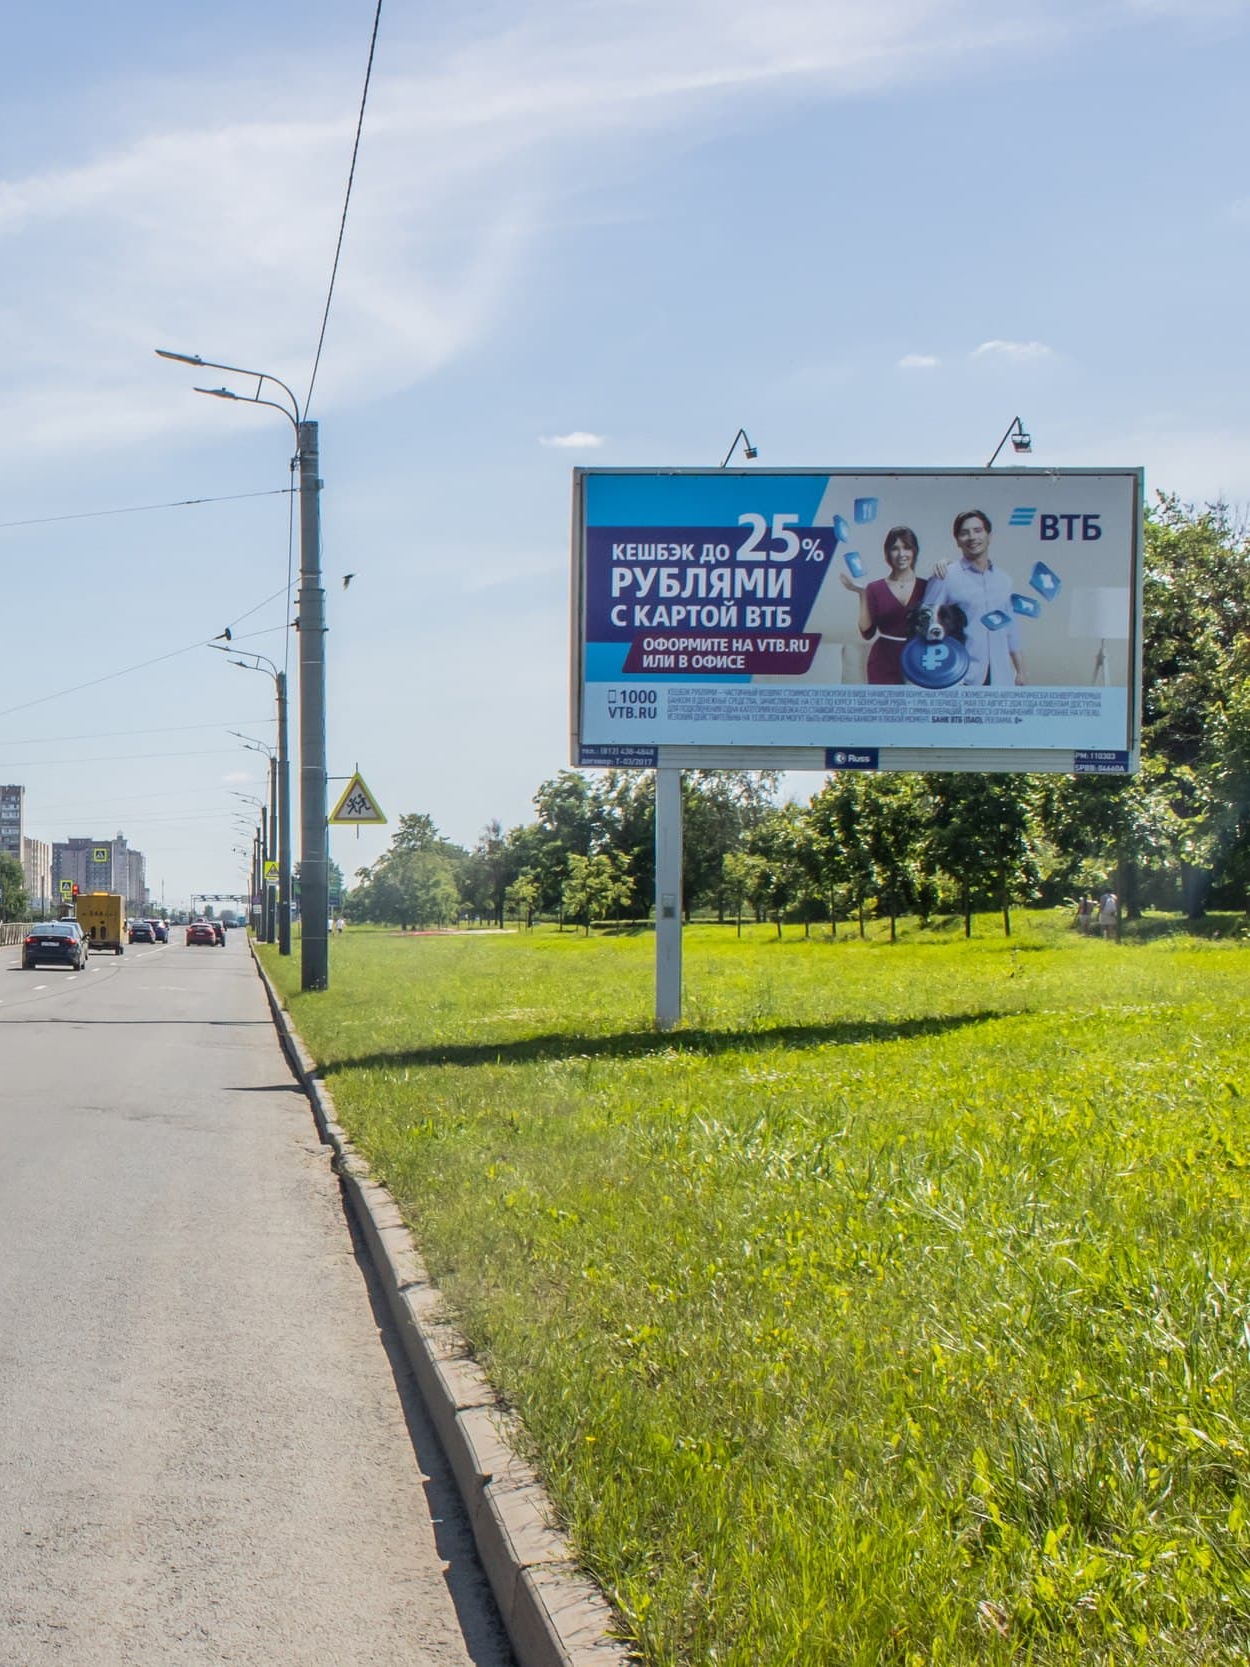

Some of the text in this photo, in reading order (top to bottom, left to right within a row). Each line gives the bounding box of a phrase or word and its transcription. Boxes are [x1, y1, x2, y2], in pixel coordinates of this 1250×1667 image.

[612, 512, 825, 564] КЕШБЭК ДО 25%
[1040, 514, 1102, 541] ВТБ
[611, 567, 792, 599] РУБЛЯМИ
[610, 600, 792, 628] С КАРТОЙ ВТБ
[643, 637, 810, 653] ОФОРМИТЕ НА VTB.RU
[642, 654, 745, 669] ИЛИ В ОФИСЕ
[620, 690, 657, 704] 1000
[608, 706, 657, 719] VTB.RU
